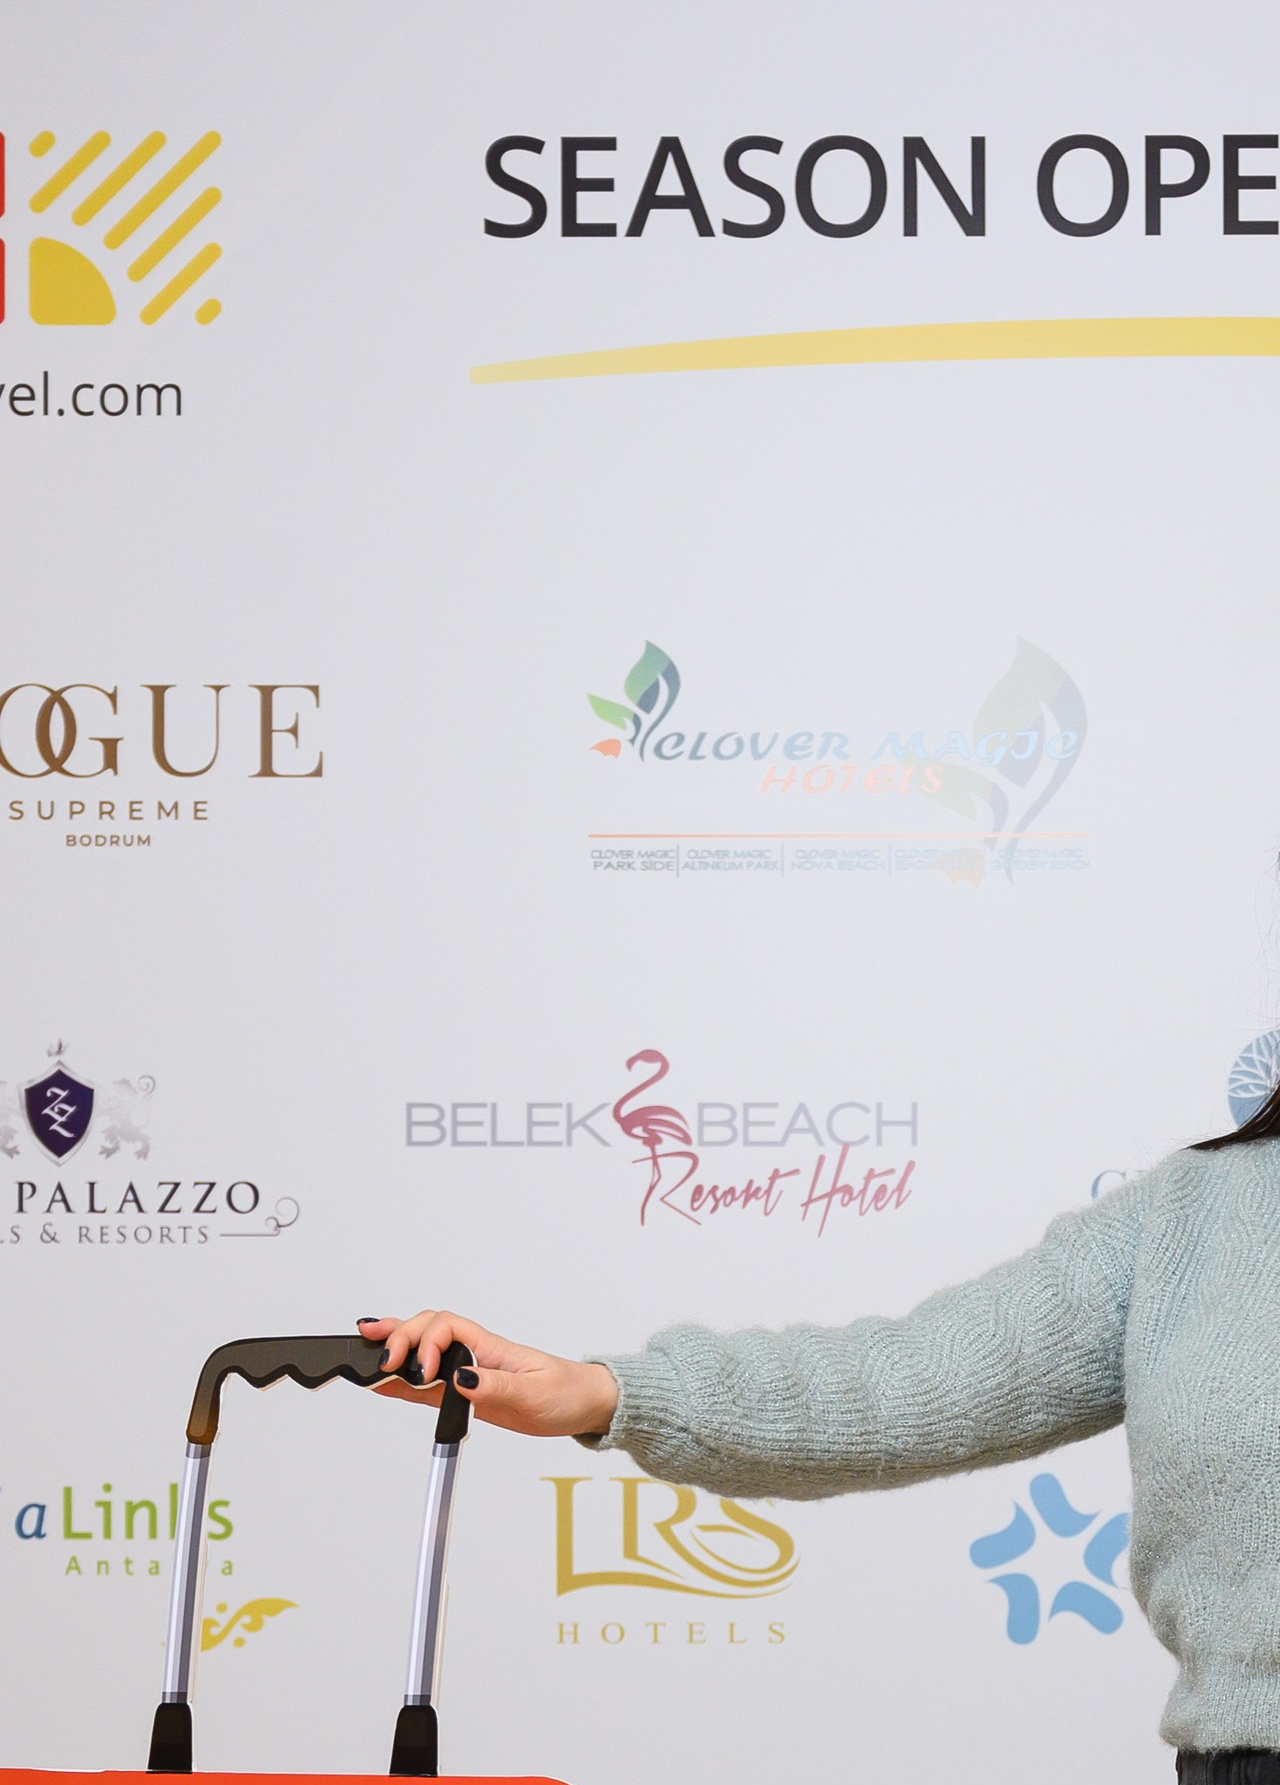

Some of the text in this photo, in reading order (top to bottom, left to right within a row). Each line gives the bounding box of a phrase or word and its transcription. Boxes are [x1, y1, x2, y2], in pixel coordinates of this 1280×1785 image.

[483, 135, 987, 238] SEASON
[653, 731, 1079, 766] CLOVER MAGIC
[759, 764, 945, 794] HOTELS
[8, 800, 209, 821] SUPREME
[65, 834, 153, 848] BODRUM
[590, 849, 676, 859] CLOVER MAGIC
[593, 860, 636, 871] PARK
[686, 849, 730, 859] CLOVER
[405, 1101, 919, 1147] BELEK BEACH
[15, 1181, 260, 1214] PALAZZO
[632, 1143, 916, 1238] Resort Hotel
[39, 1222, 61, 1244] &
[77, 1225, 209, 1245] RESORTS
[539, 1477, 800, 1599] LRS
[64, 1555, 234, 1576] Antaa
[556, 1621, 787, 1645] HOTELS
